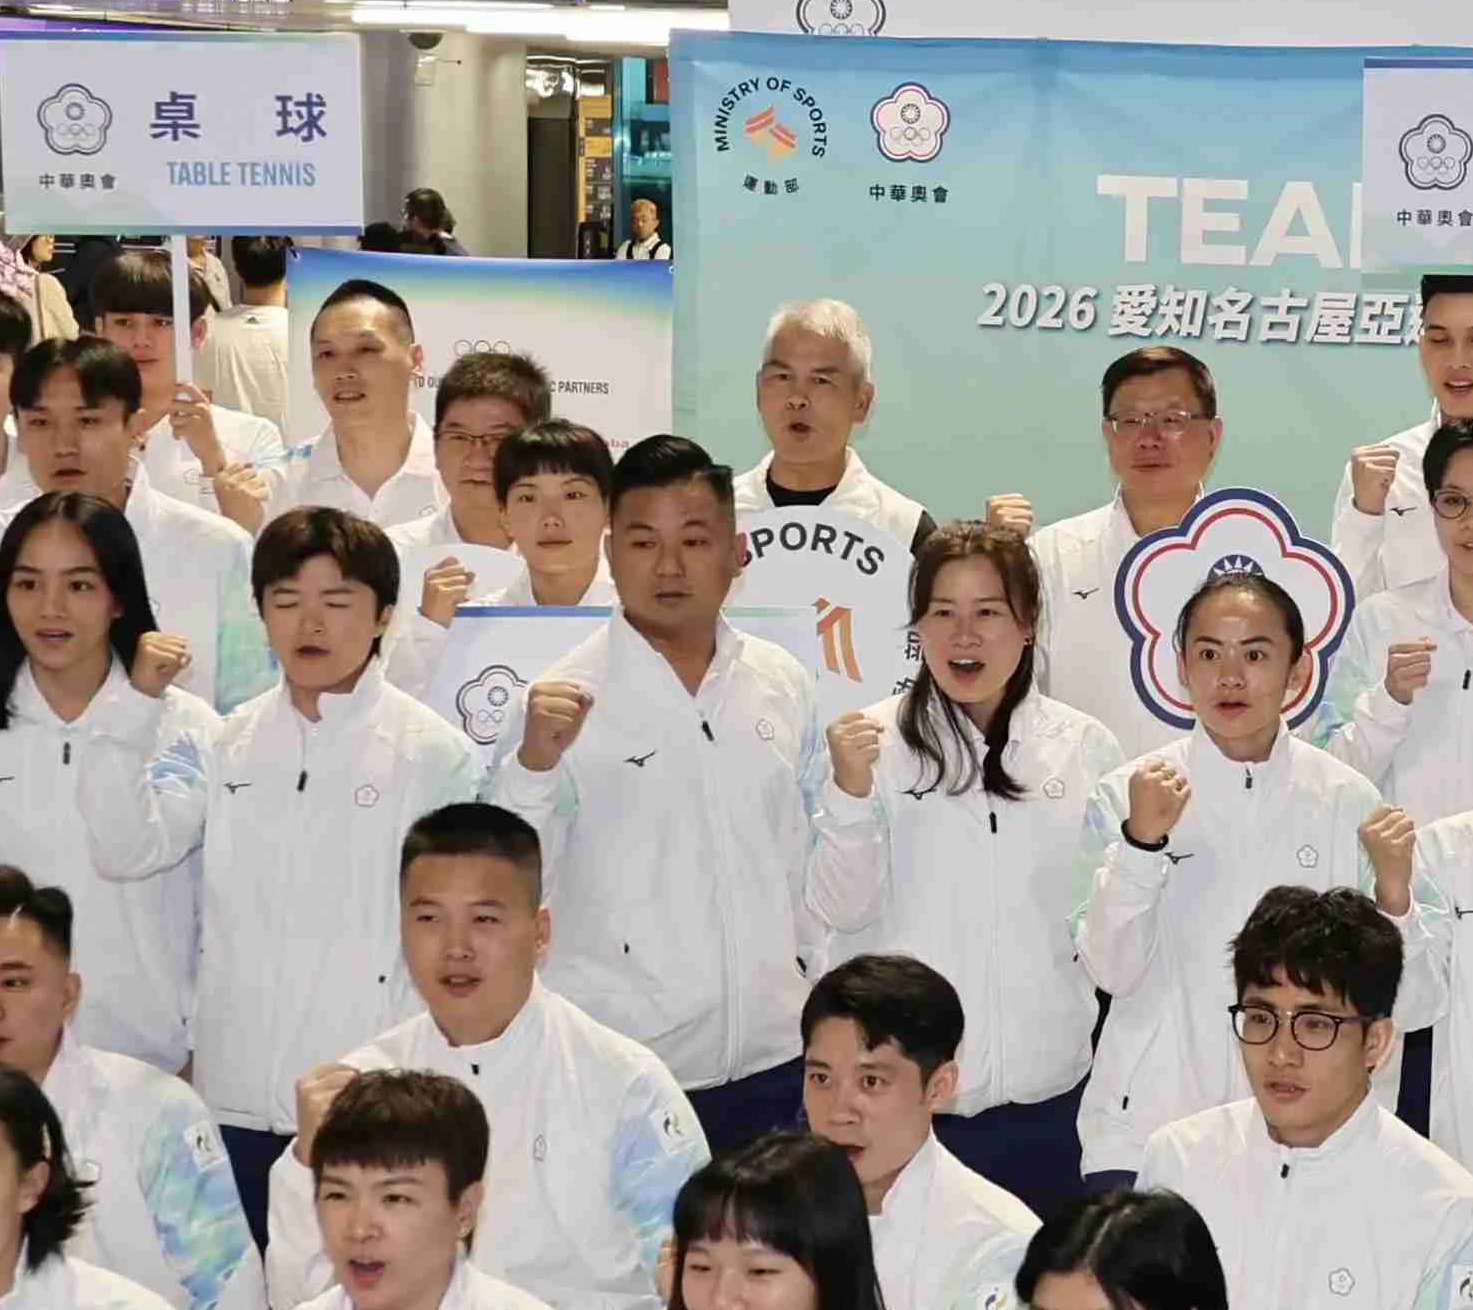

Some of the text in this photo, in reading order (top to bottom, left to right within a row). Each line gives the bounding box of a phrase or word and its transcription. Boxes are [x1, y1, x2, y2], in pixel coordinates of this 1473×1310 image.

[713, 76, 827, 158] MINISTRY OF SPORTS
[38, 173, 117, 192] 中華奧會
[166, 160, 317, 188] TABLE TENNIS
[869, 185, 949, 203] 中華奧會
[1097, 174, 1363, 271] TEA
[977, 281, 1098, 330] 2026
[558, 381, 610, 394] PARTNERS
[743, 521, 886, 576] PORTS
